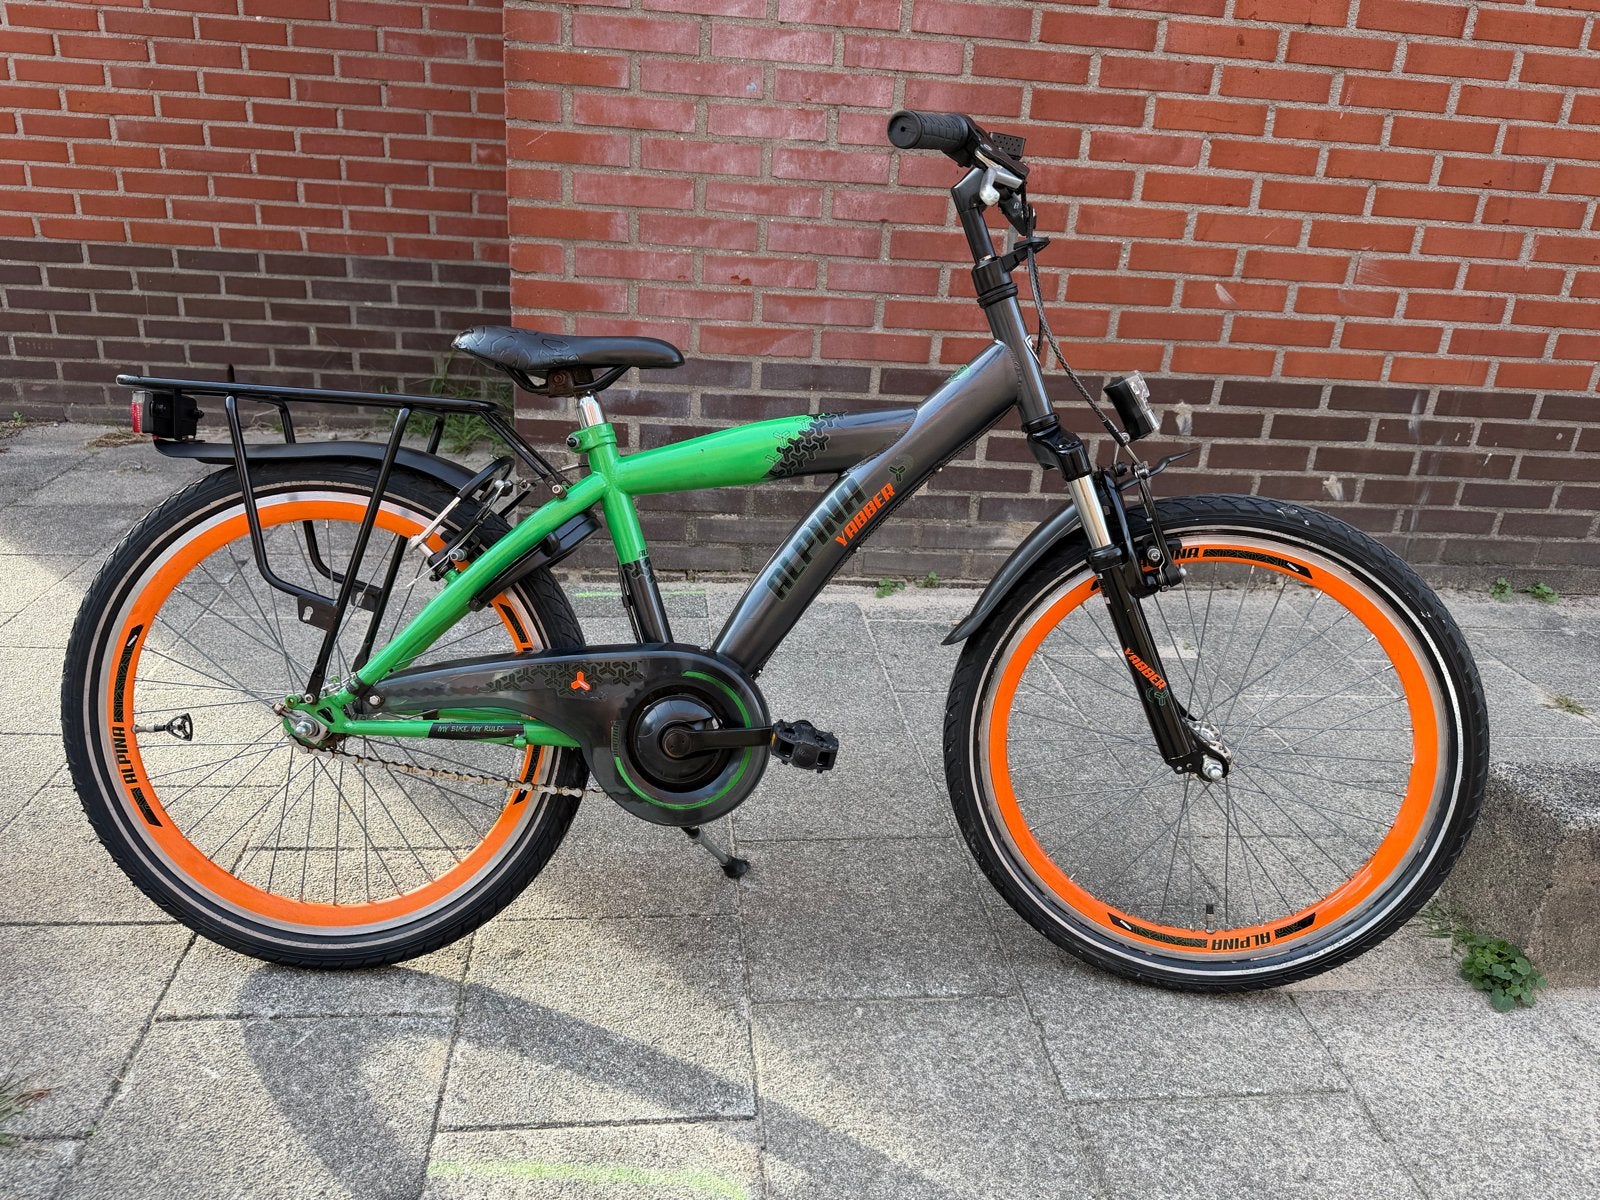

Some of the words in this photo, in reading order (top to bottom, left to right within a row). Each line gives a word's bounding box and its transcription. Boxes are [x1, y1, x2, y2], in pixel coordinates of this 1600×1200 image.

[767, 476, 867, 600] ALPINA
[835, 483, 895, 547] YABBER
[1125, 647, 1167, 690] YABBER
[437, 725, 449, 733] MY
[470, 725, 482, 733] MY
[112, 727, 138, 785] ALPINA
[1211, 932, 1271, 951] ALPINA
